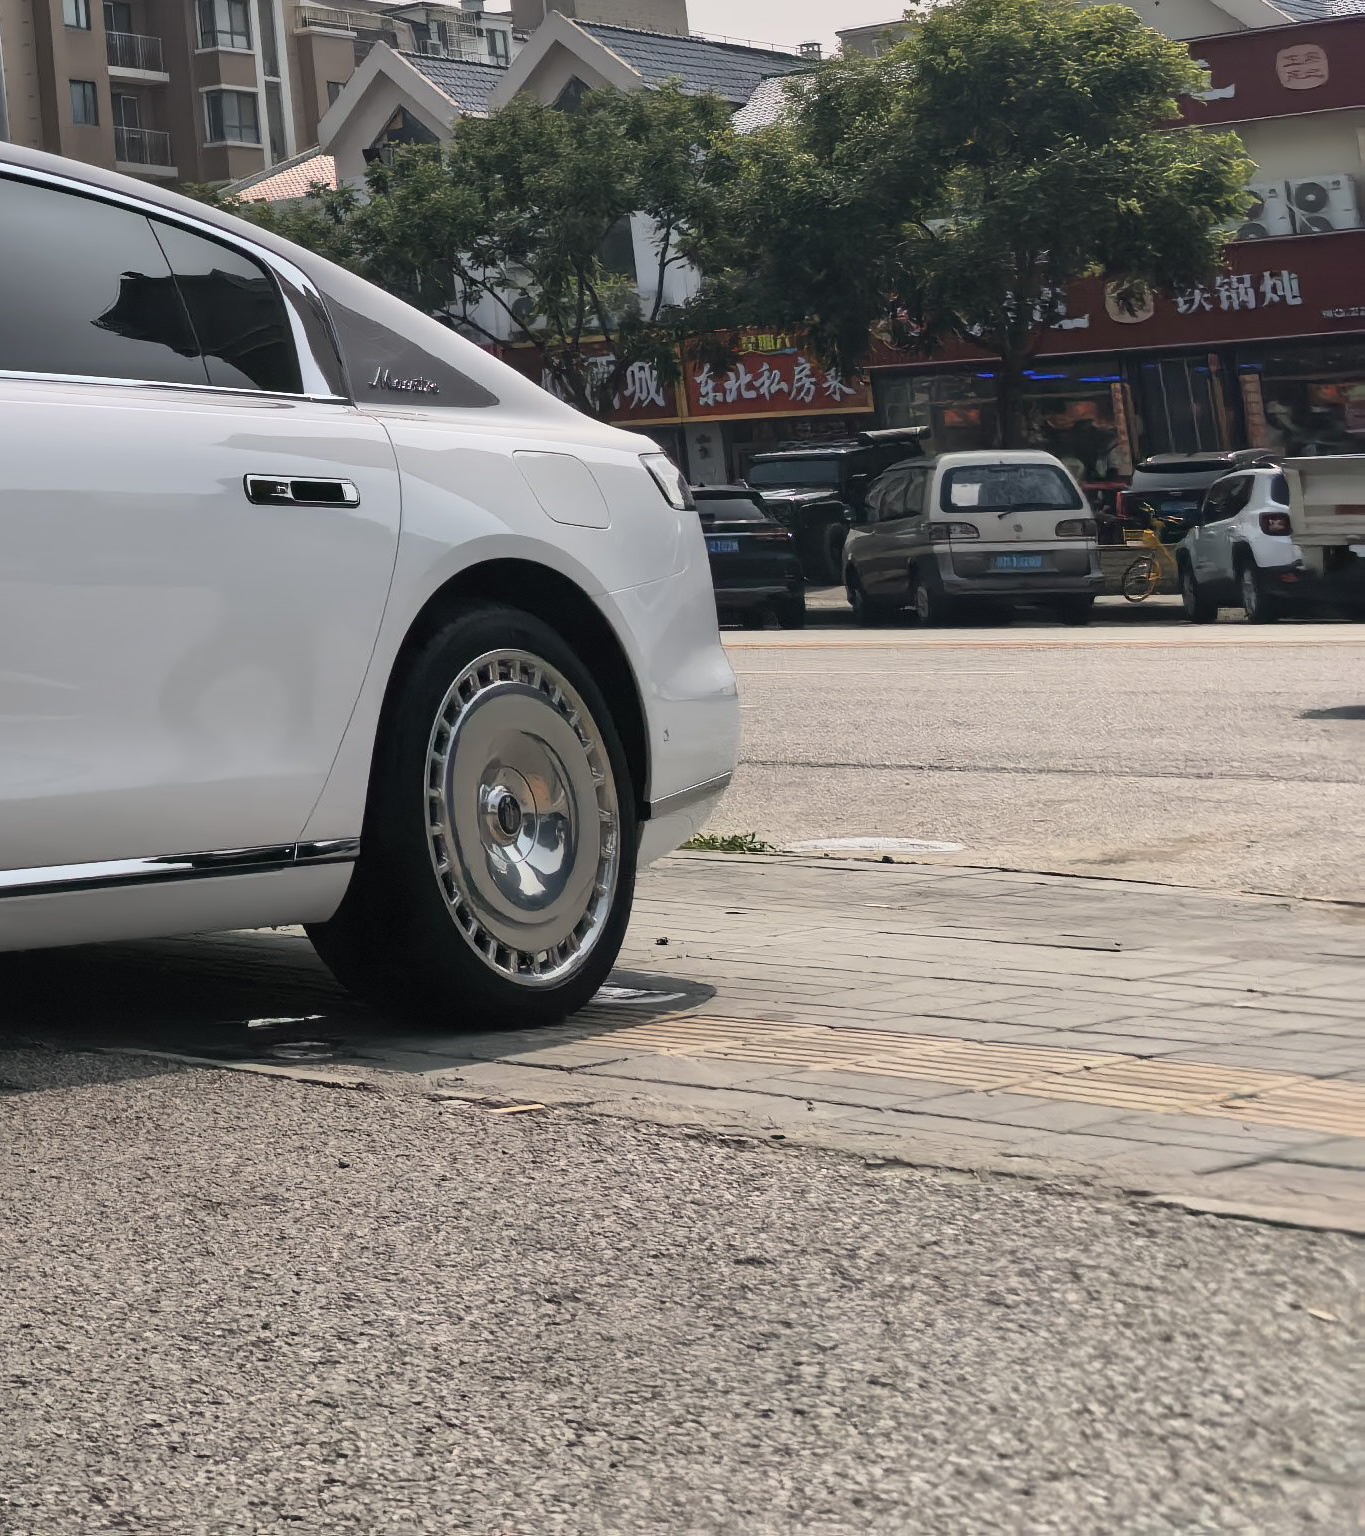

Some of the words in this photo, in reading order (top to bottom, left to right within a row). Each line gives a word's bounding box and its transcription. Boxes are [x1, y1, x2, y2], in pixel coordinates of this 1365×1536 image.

[693, 356, 857, 407] 东北私房菜
